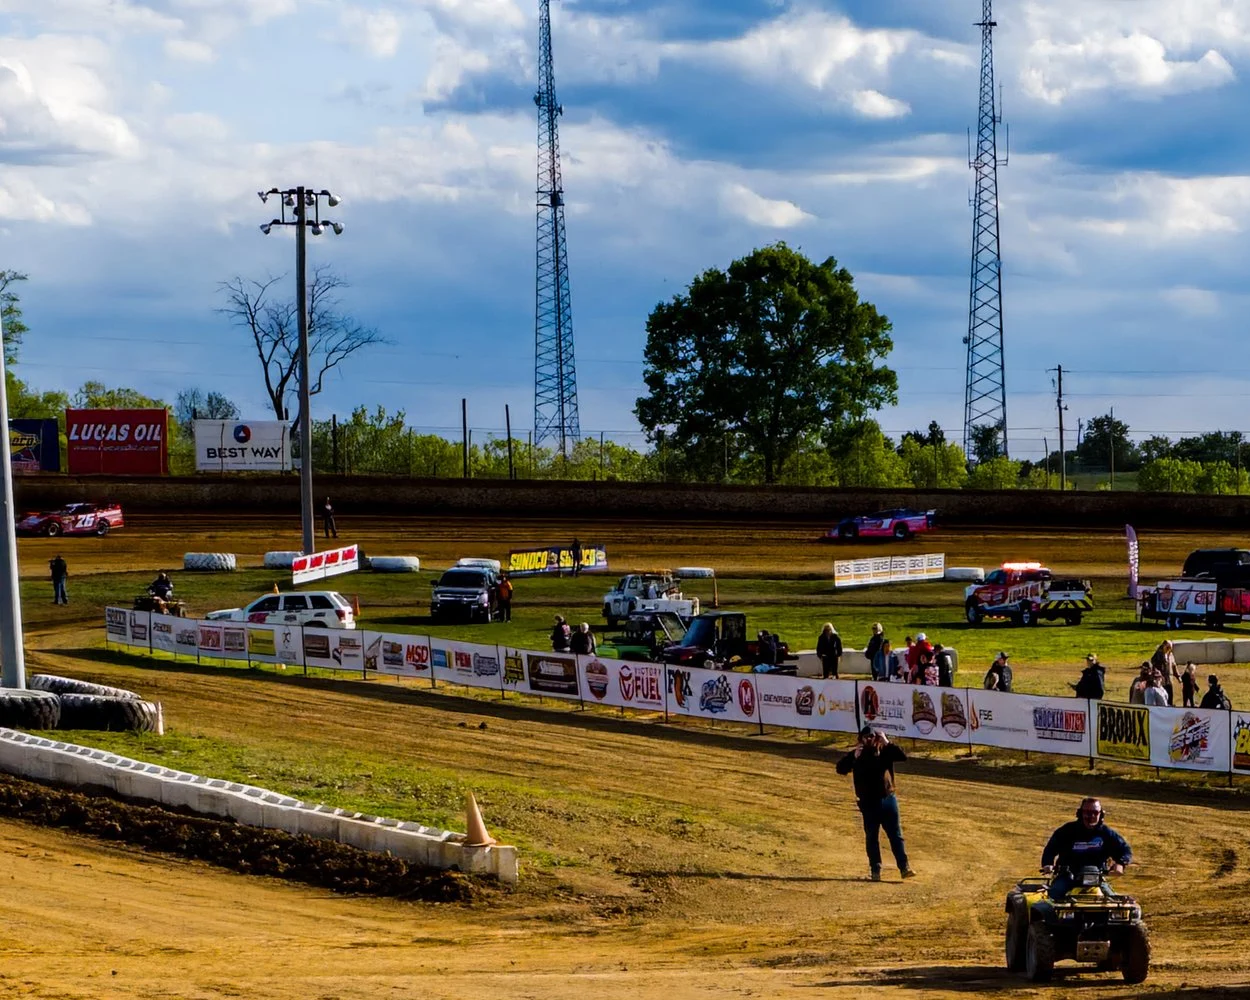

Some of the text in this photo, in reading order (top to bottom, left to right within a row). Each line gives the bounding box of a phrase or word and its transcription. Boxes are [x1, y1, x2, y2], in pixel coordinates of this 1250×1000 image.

[69, 423, 162, 442] LUCAS OIL
[206, 447, 282, 459] BEST WAY
[406, 644, 429, 664] MSD
[635, 676, 662, 701] FUEL
[1099, 705, 1148, 747] BRODIX
